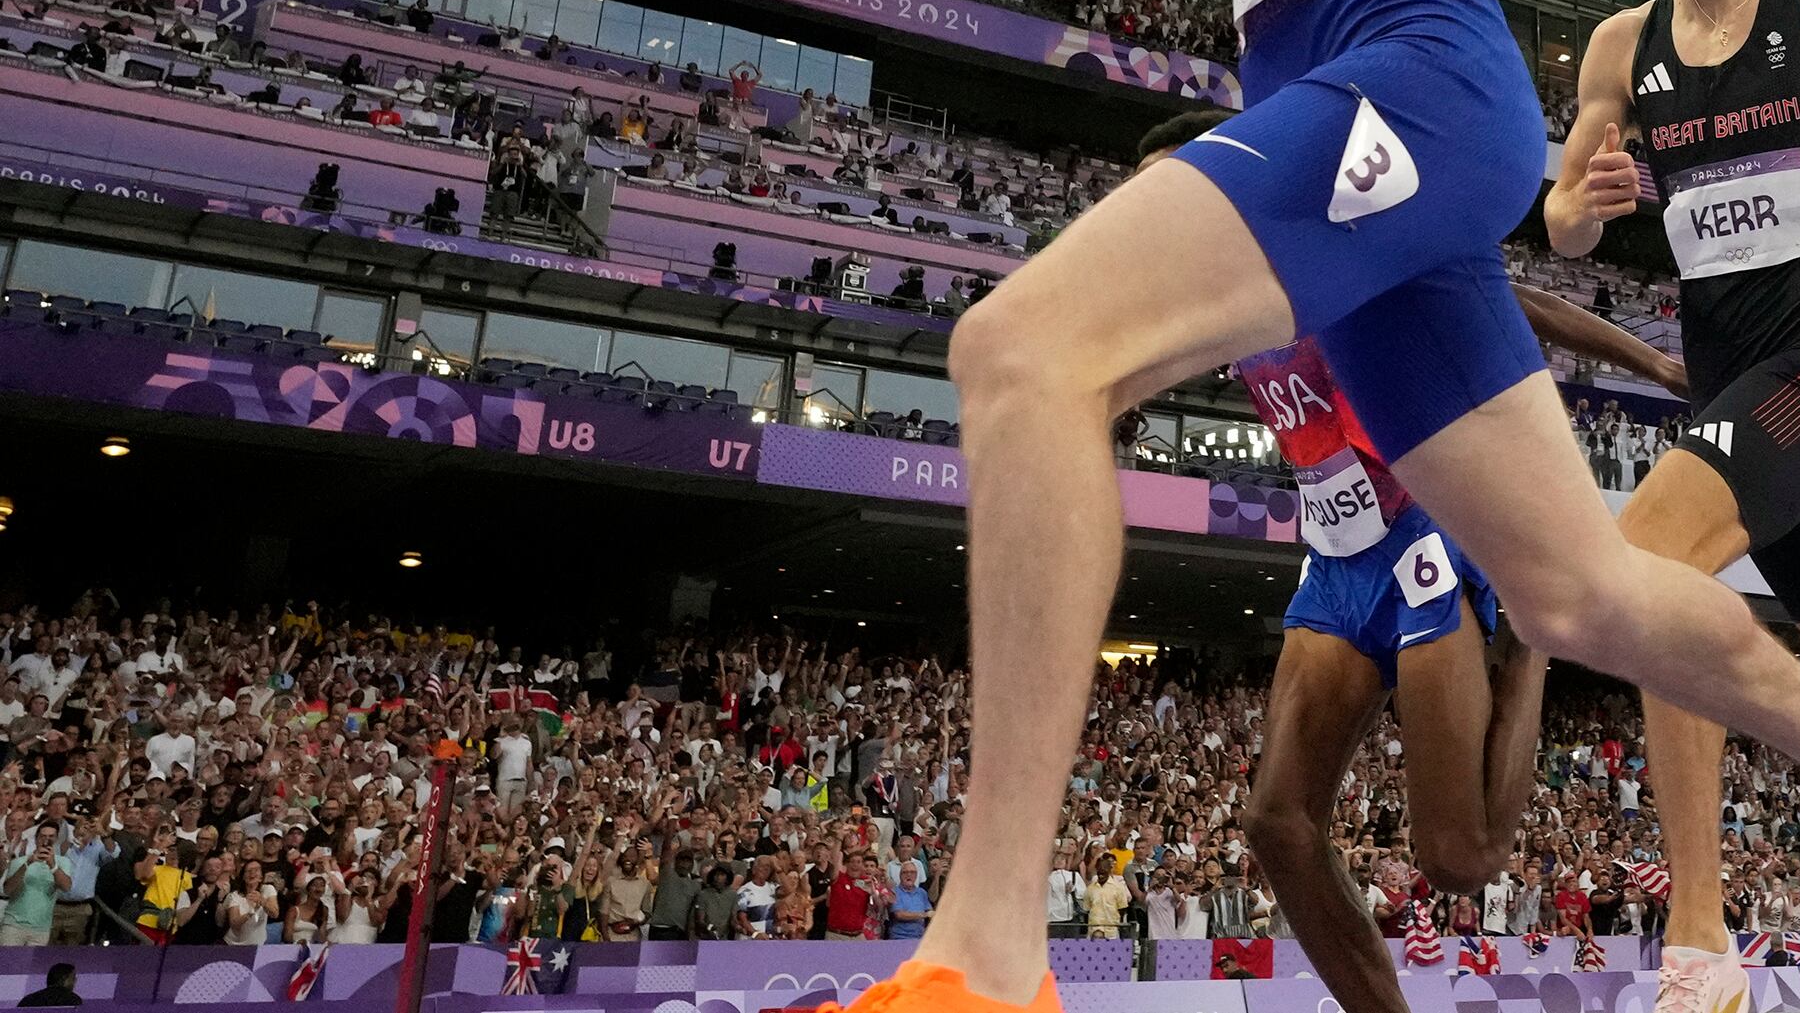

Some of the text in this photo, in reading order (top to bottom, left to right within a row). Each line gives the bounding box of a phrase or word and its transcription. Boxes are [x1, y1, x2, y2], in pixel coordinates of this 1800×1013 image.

[1651, 96, 1800, 151] GREAT BRITAIN
[1344, 141, 1391, 193] 3
[1691, 161, 1761, 183] PARIS 2024
[1690, 194, 1780, 240] KERR
[549, 419, 596, 452] U8
[709, 439, 752, 471] U7
[892, 457, 958, 488] PAR
[1414, 552, 1439, 588] 6
